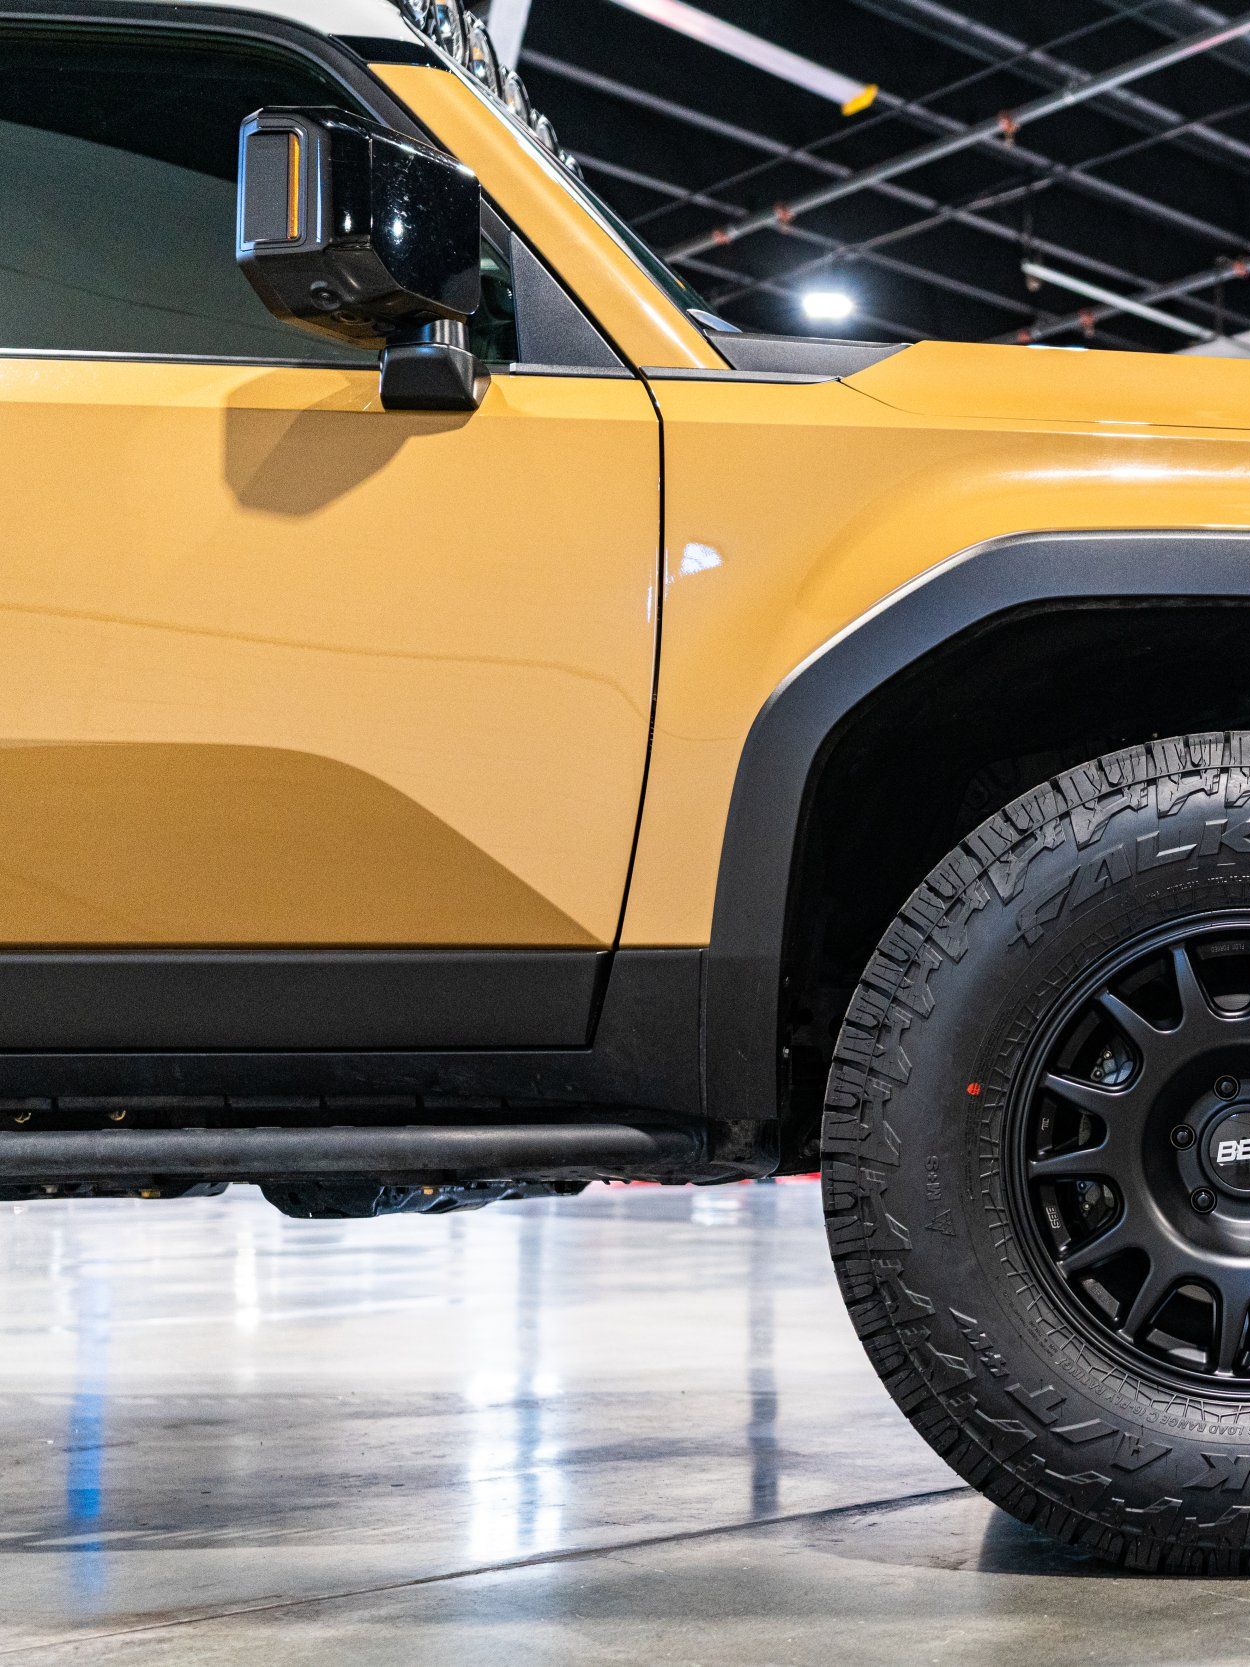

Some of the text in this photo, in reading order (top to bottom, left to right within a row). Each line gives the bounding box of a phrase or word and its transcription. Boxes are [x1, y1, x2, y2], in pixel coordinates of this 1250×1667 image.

[925, 1155, 941, 1201] M+S
[1046, 1206, 1060, 1228] BBS
[1144, 1411, 1159, 1427] C
[1158, 1414, 1206, 1435] RANGE
[1207, 1424, 1244, 1438] LOAD
